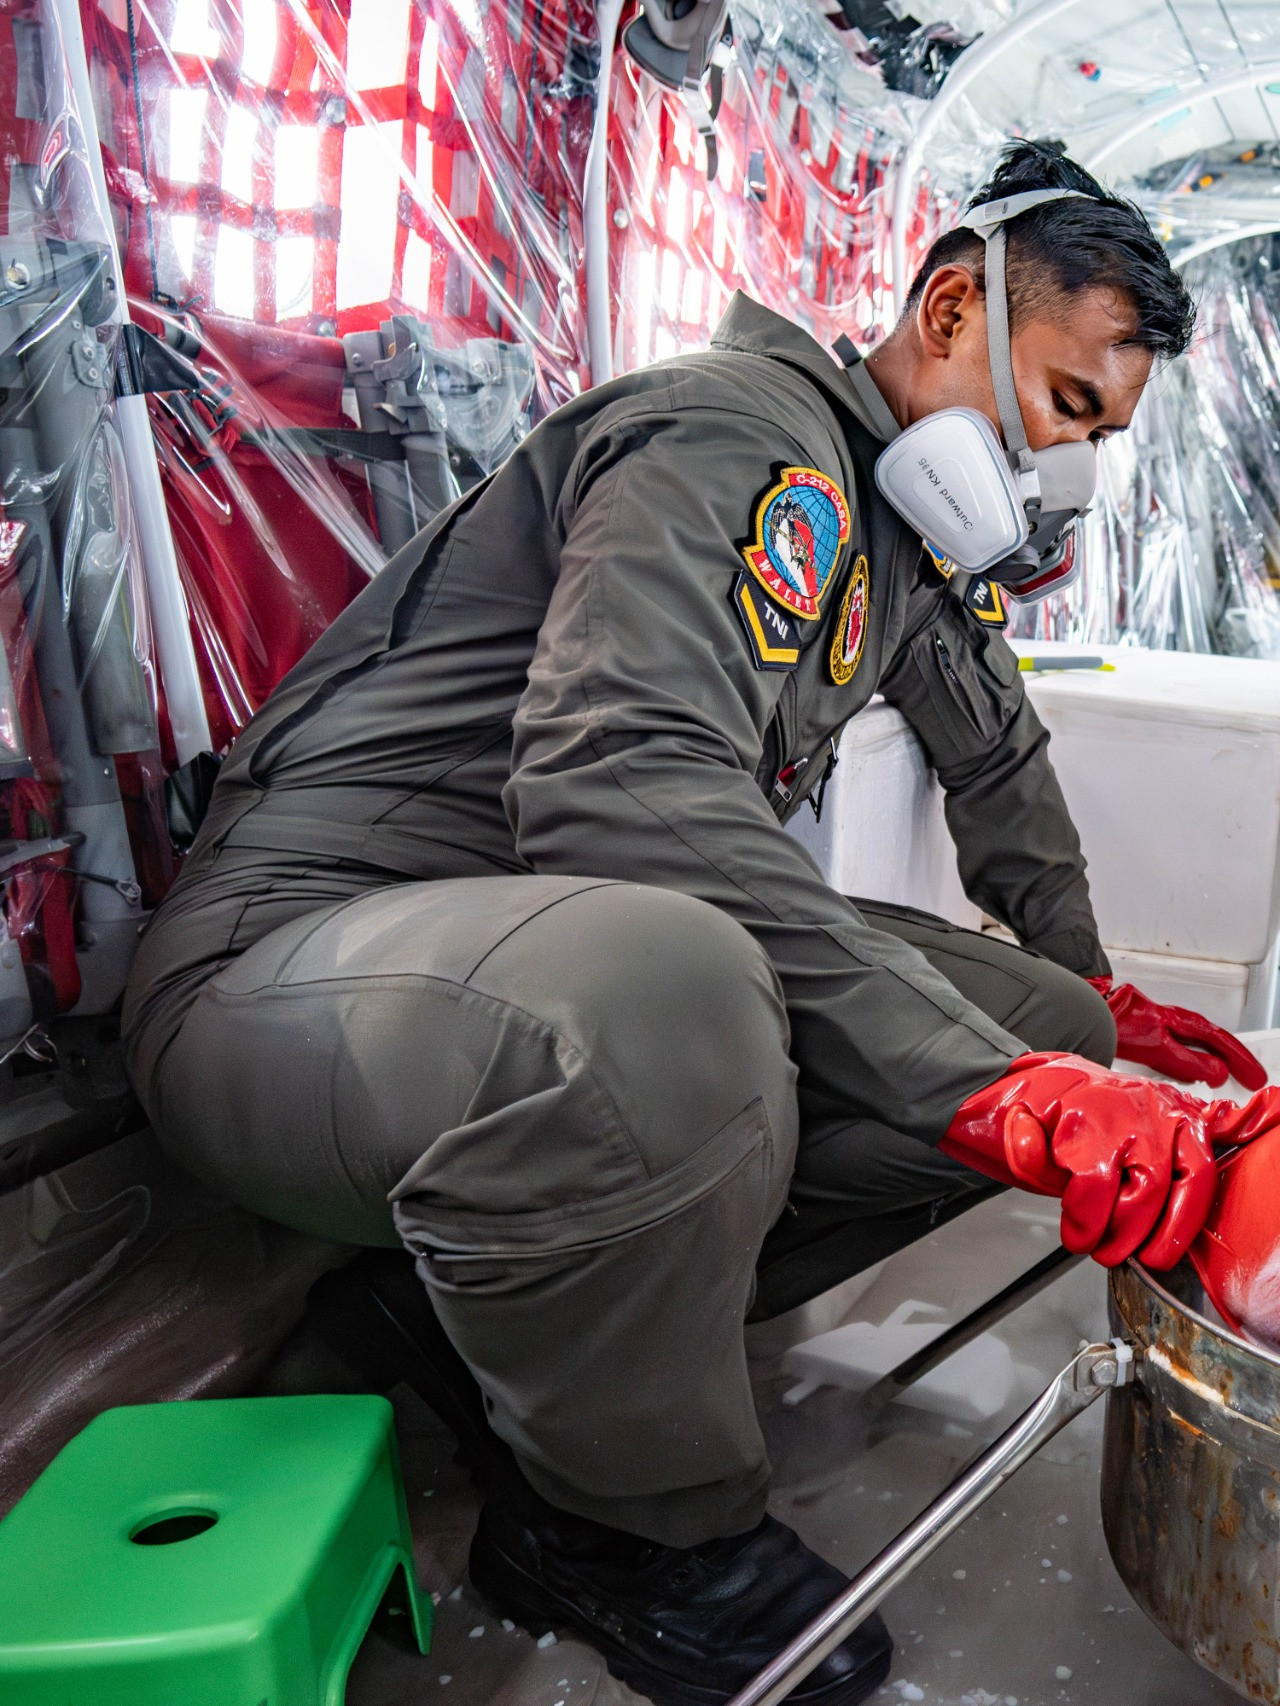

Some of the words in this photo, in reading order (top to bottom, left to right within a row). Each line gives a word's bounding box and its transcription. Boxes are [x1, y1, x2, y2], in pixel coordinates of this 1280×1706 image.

[796, 473, 830, 493] C-212
[830, 490, 848, 532] CASA
[758, 559, 812, 612] WALET
[973, 582, 989, 605] TNI
[764, 602, 790, 641] TNI
